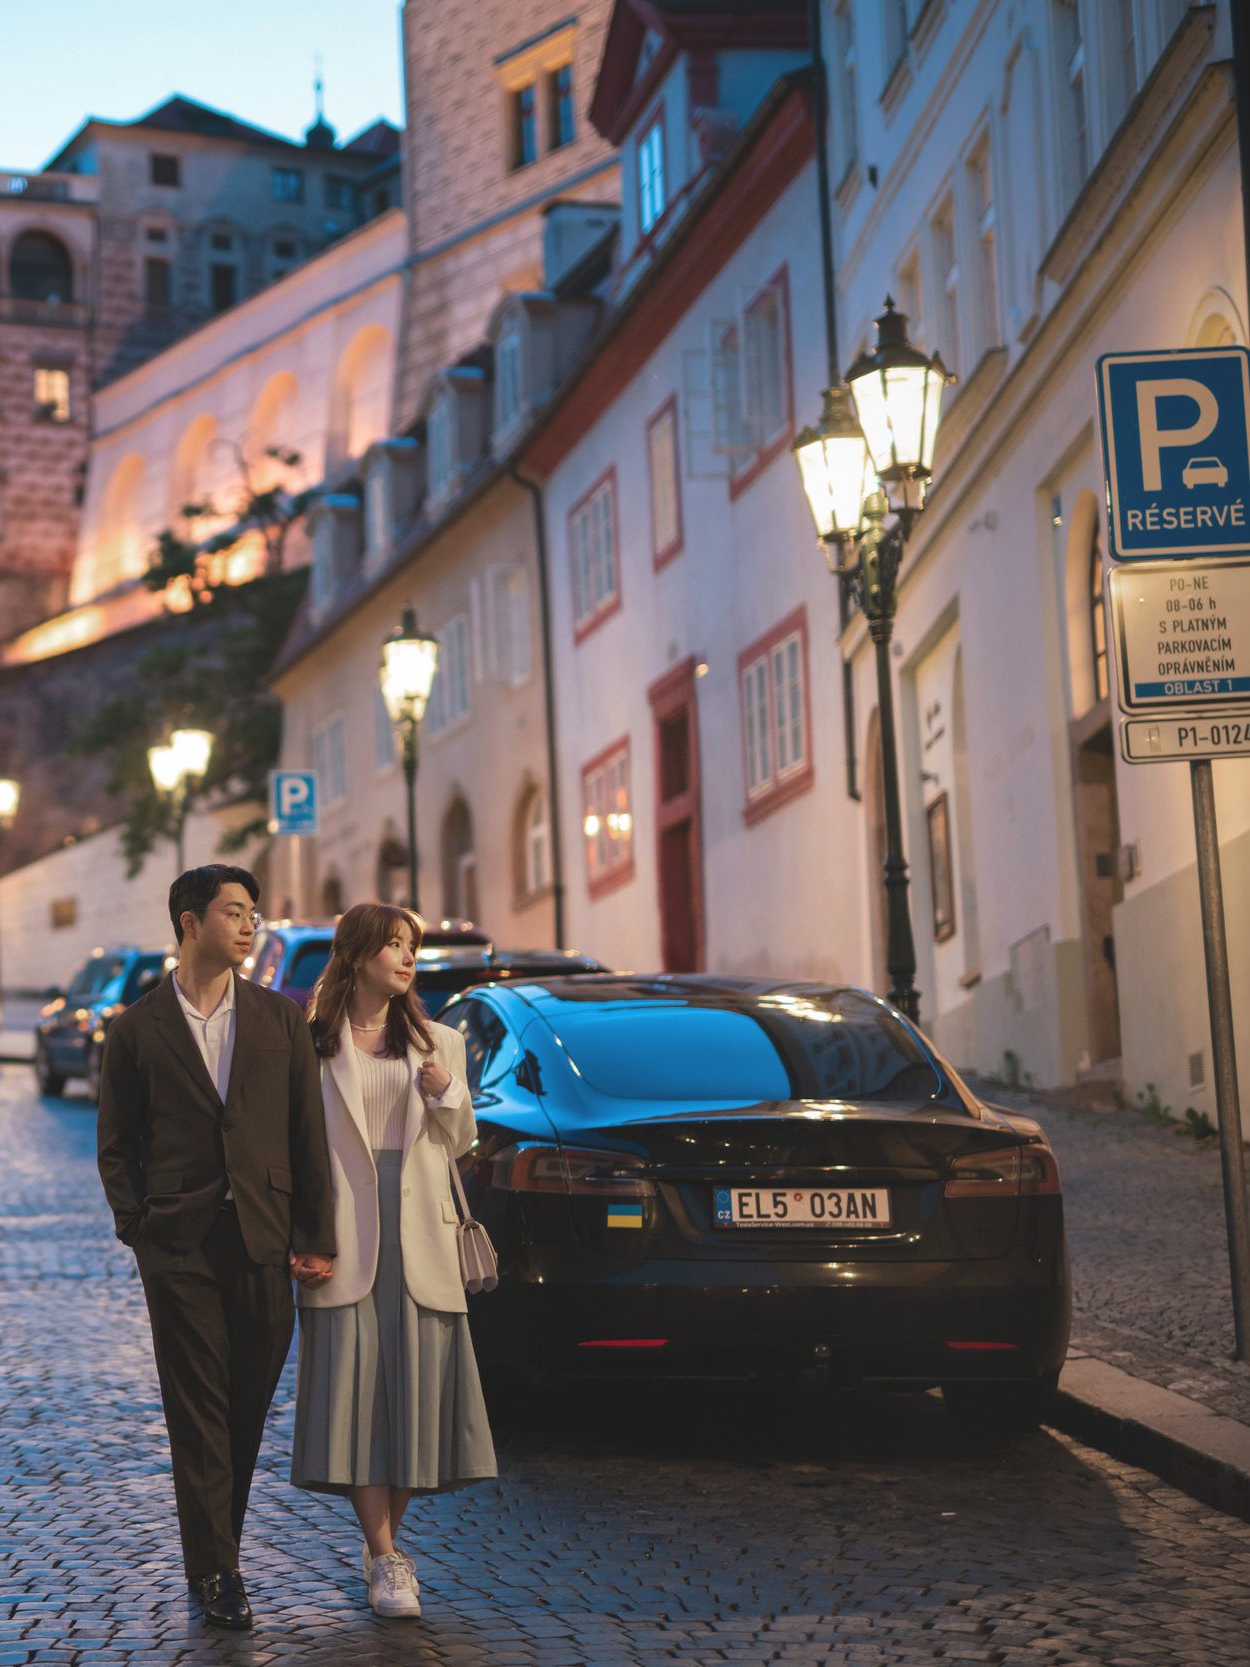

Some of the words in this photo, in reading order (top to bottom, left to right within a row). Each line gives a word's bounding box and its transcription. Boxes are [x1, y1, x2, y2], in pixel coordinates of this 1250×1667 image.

[1135, 378, 1220, 492] P
[1127, 498, 1246, 532] RÉSERVÉ
[1169, 576, 1209, 592] PO-NE
[1166, 597, 1204, 613] 08-06
[1209, 596, 1217, 610] h
[1159, 620, 1167, 634] S
[1173, 614, 1227, 633] PLATNÝM
[1157, 634, 1232, 655] PARKOVACÍM
[1158, 655, 1236, 676] OPRÁVNĚNÍM
[1164, 679, 1220, 696] OBLAST
[1227, 679, 1233, 691] 1
[281, 779, 309, 815] P
[718, 1210, 731, 1219] CZ
[738, 1192, 788, 1219] EL5
[810, 1192, 877, 1219] 03AN
